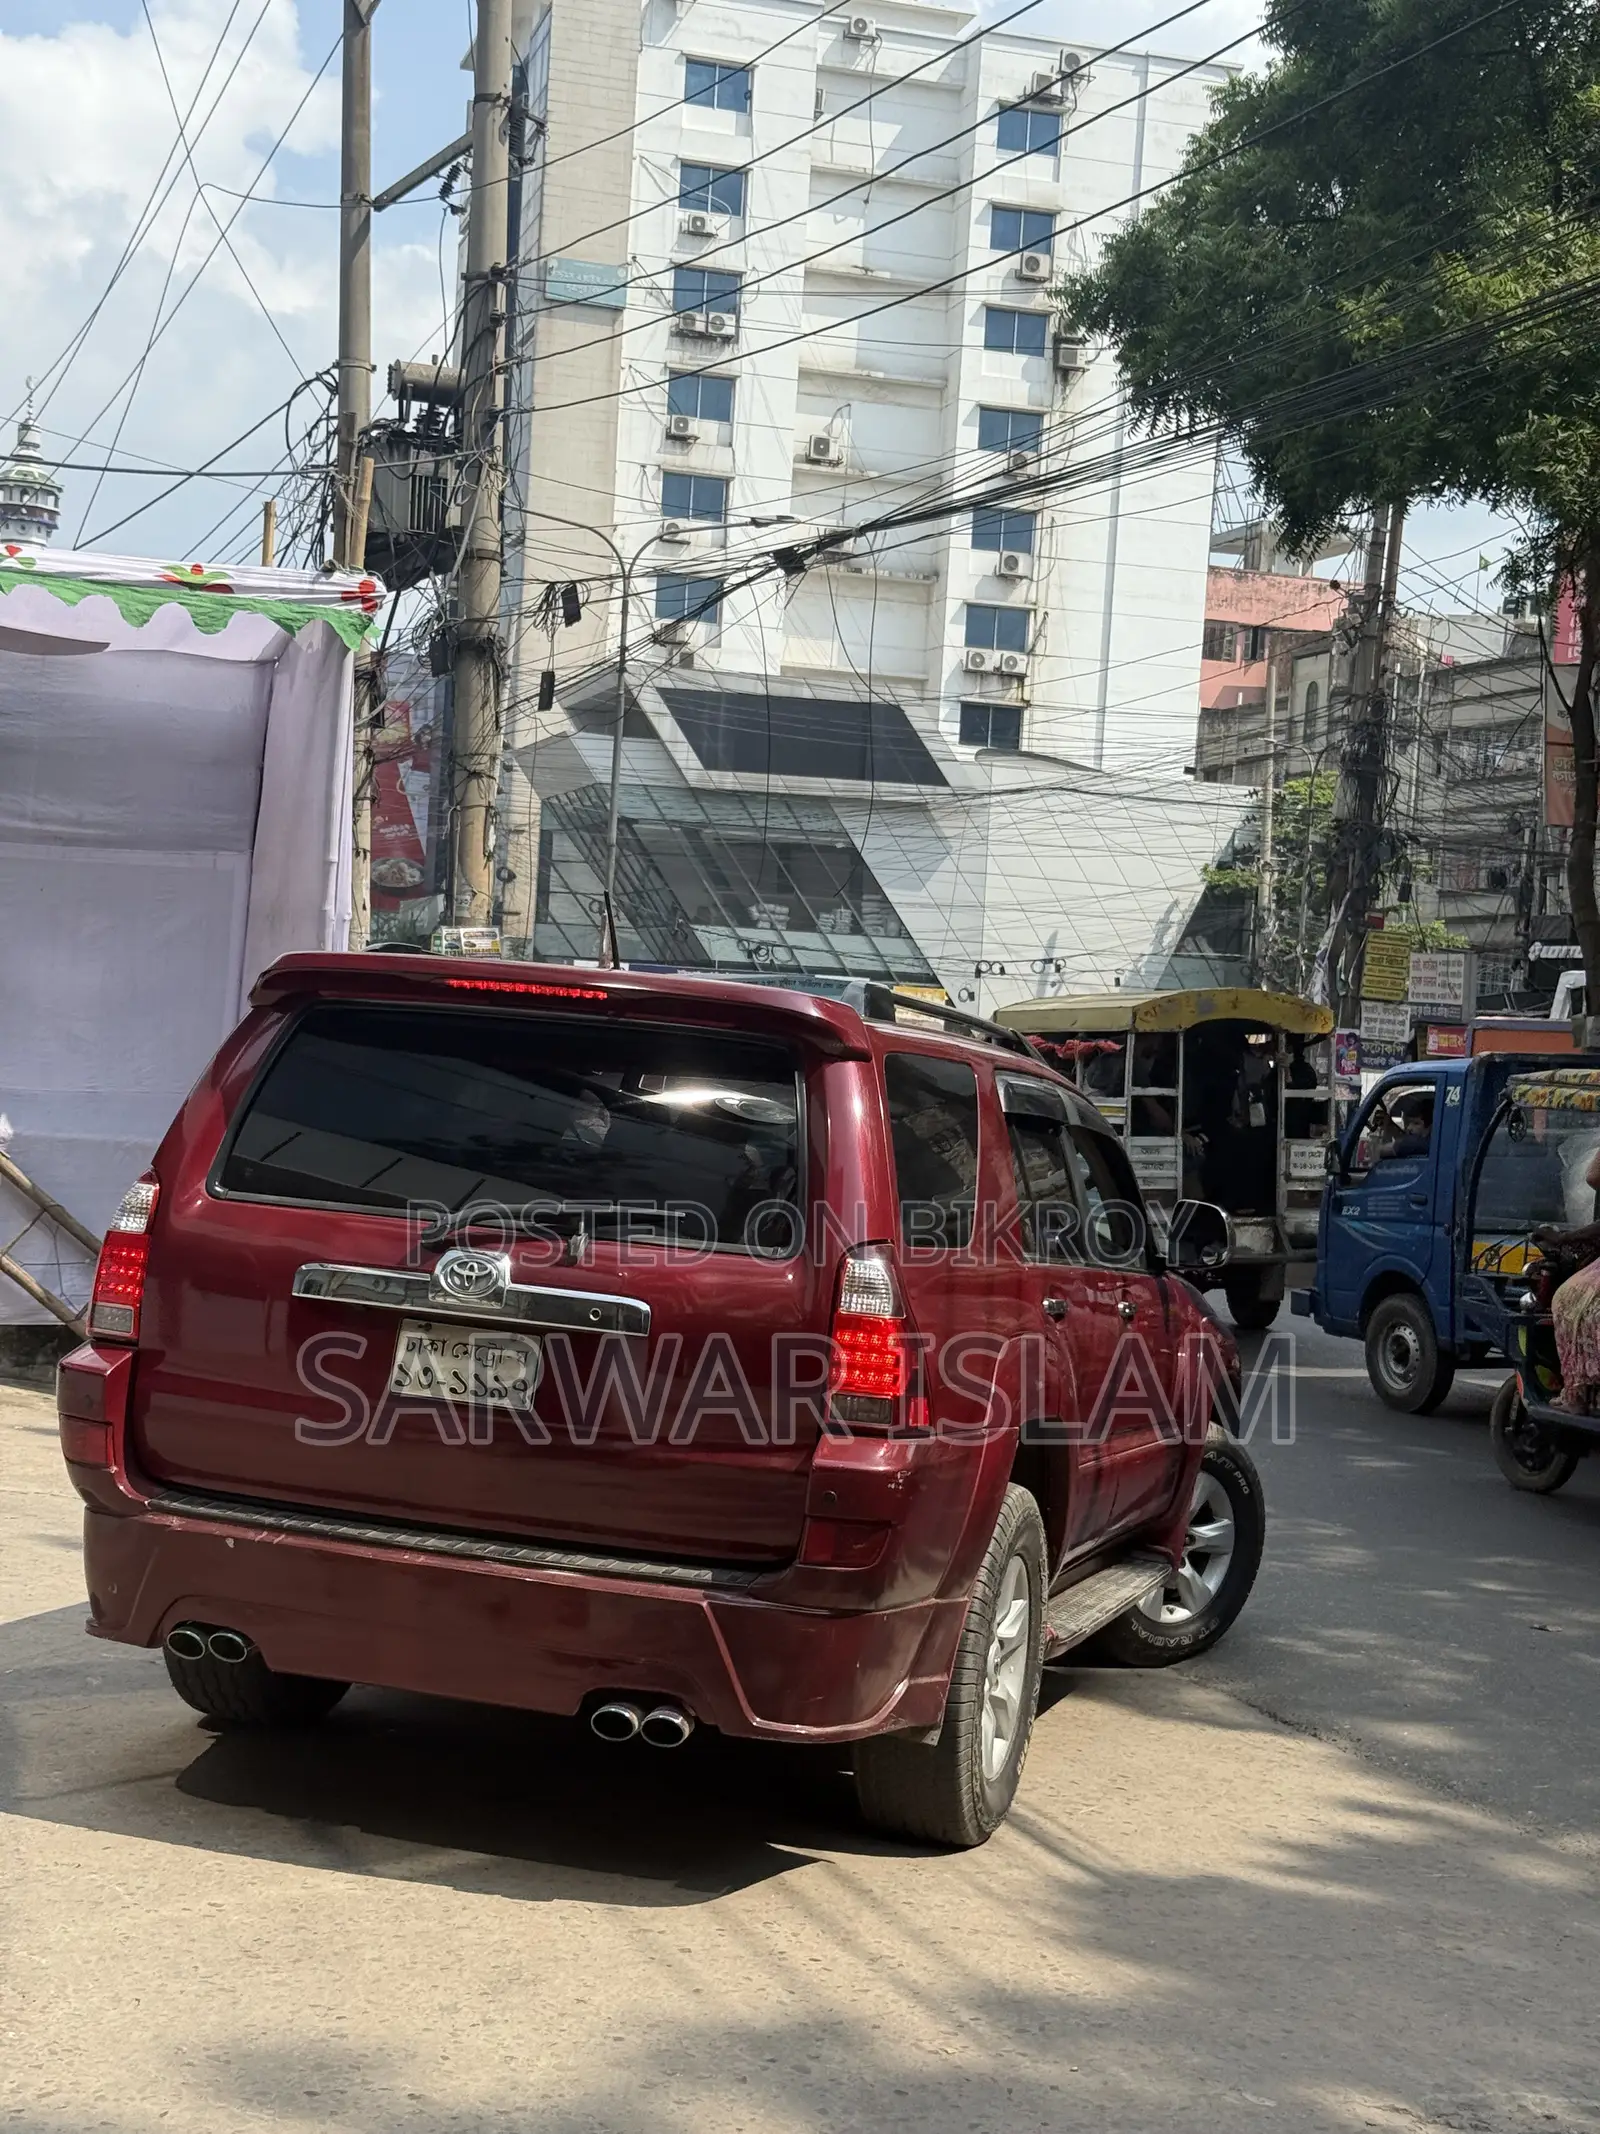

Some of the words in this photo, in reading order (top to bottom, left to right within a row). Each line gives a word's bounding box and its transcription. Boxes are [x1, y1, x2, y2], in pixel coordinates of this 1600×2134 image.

[1445, 1086, 1462, 1103] 74
[1341, 1206, 1361, 1217] EX2
[406, 1335, 449, 1357] ঢাকা
[394, 1362, 528, 1405] ১৩-১১৯৭
[1233, 1470, 1250, 1494] PRO
[1130, 1618, 1193, 1648] RADIAL
